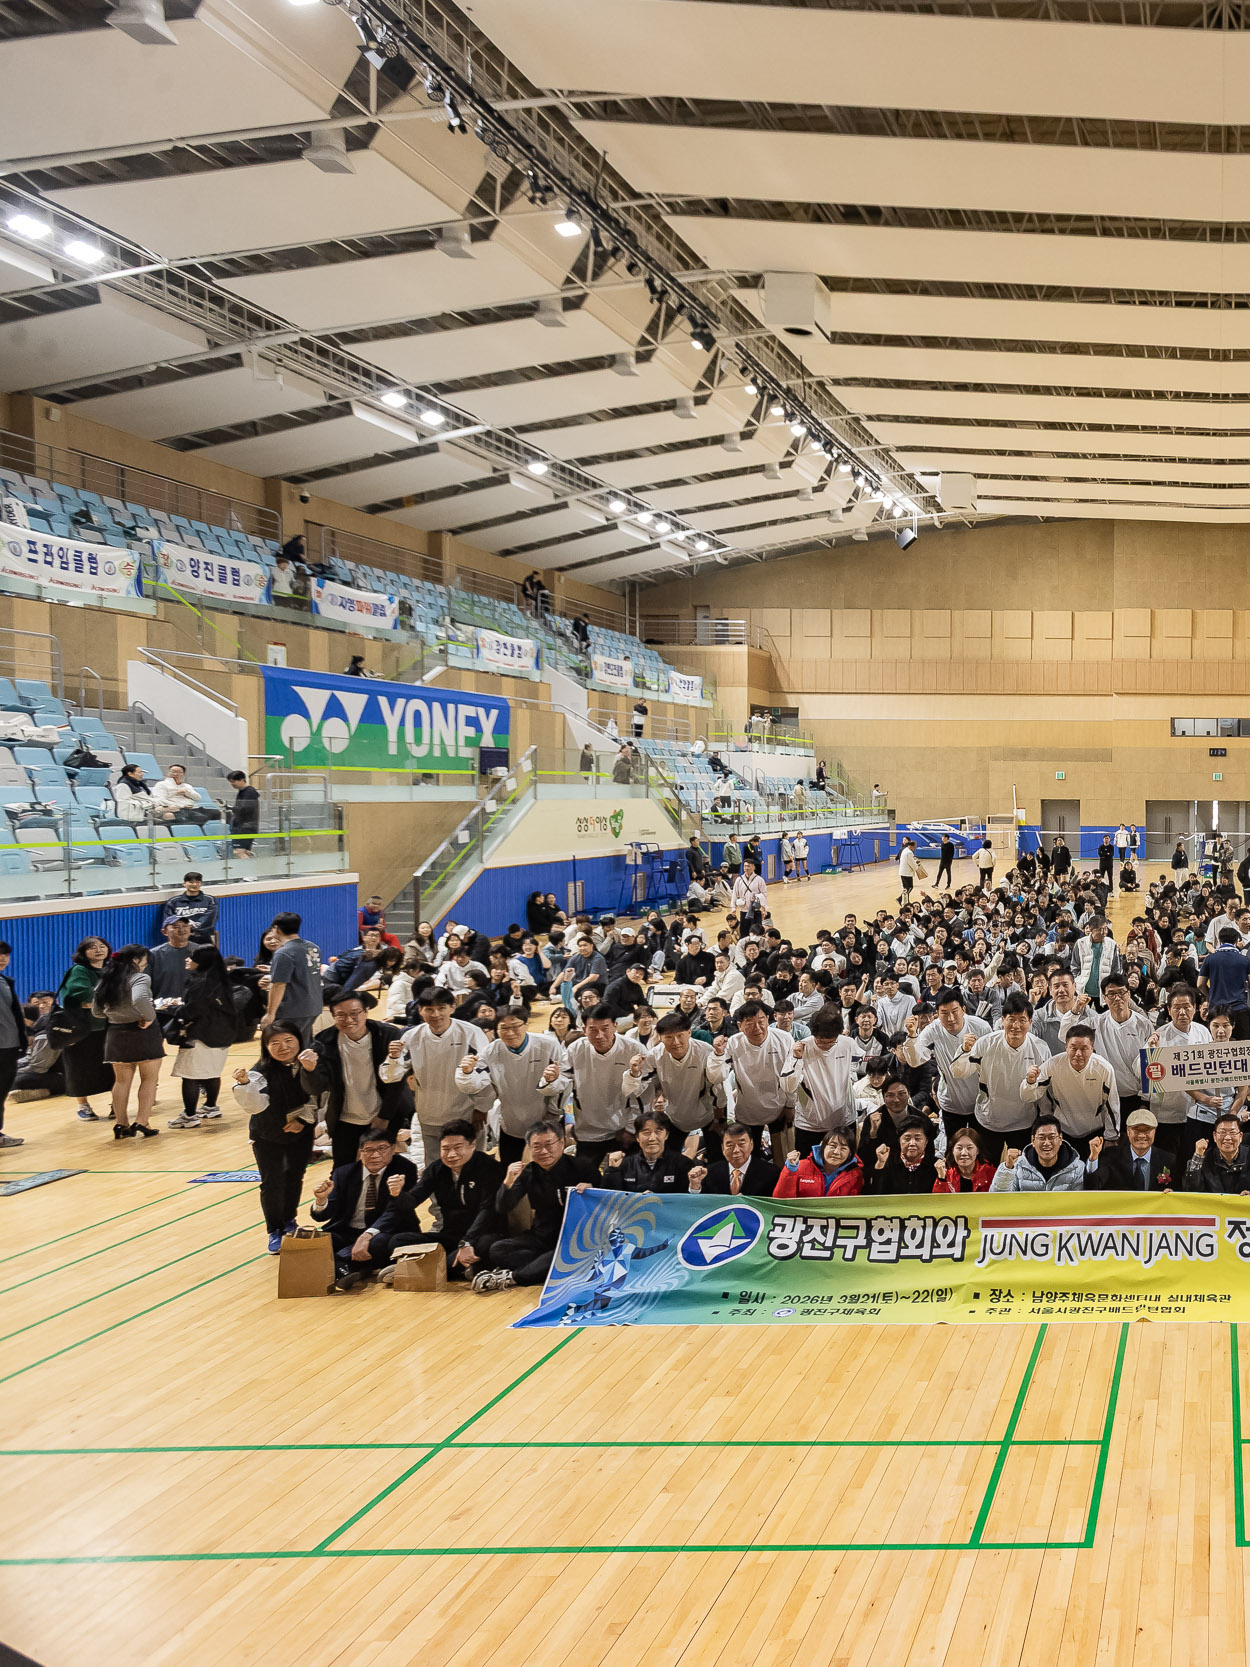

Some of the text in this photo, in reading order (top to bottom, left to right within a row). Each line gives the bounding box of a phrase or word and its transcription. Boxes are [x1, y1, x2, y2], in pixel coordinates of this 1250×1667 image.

[27, 540, 98, 576] 프라임클럽
[189, 557, 240, 587] 양진클럽
[376, 696, 499, 758] YONEX
[1173, 1050, 1205, 1061] 제31회
[1149, 1066, 1162, 1078] 필
[770, 1216, 969, 1263] 광진구협회와
[978, 1231, 1050, 1264] JUNG
[738, 1291, 766, 1305] 일시
[780, 1294, 834, 1305] 2026년
[837, 1288, 953, 1305] 3월21(토)~22(일)
[989, 1288, 1015, 1303] 장소
[1031, 1290, 1162, 1304] 남양주체육문화센터내
[1167, 1294, 1232, 1304] 실내체육관
[728, 1307, 756, 1317] 주최
[800, 1307, 882, 1317] 광진구체육회
[985, 1307, 1012, 1315] 주관
